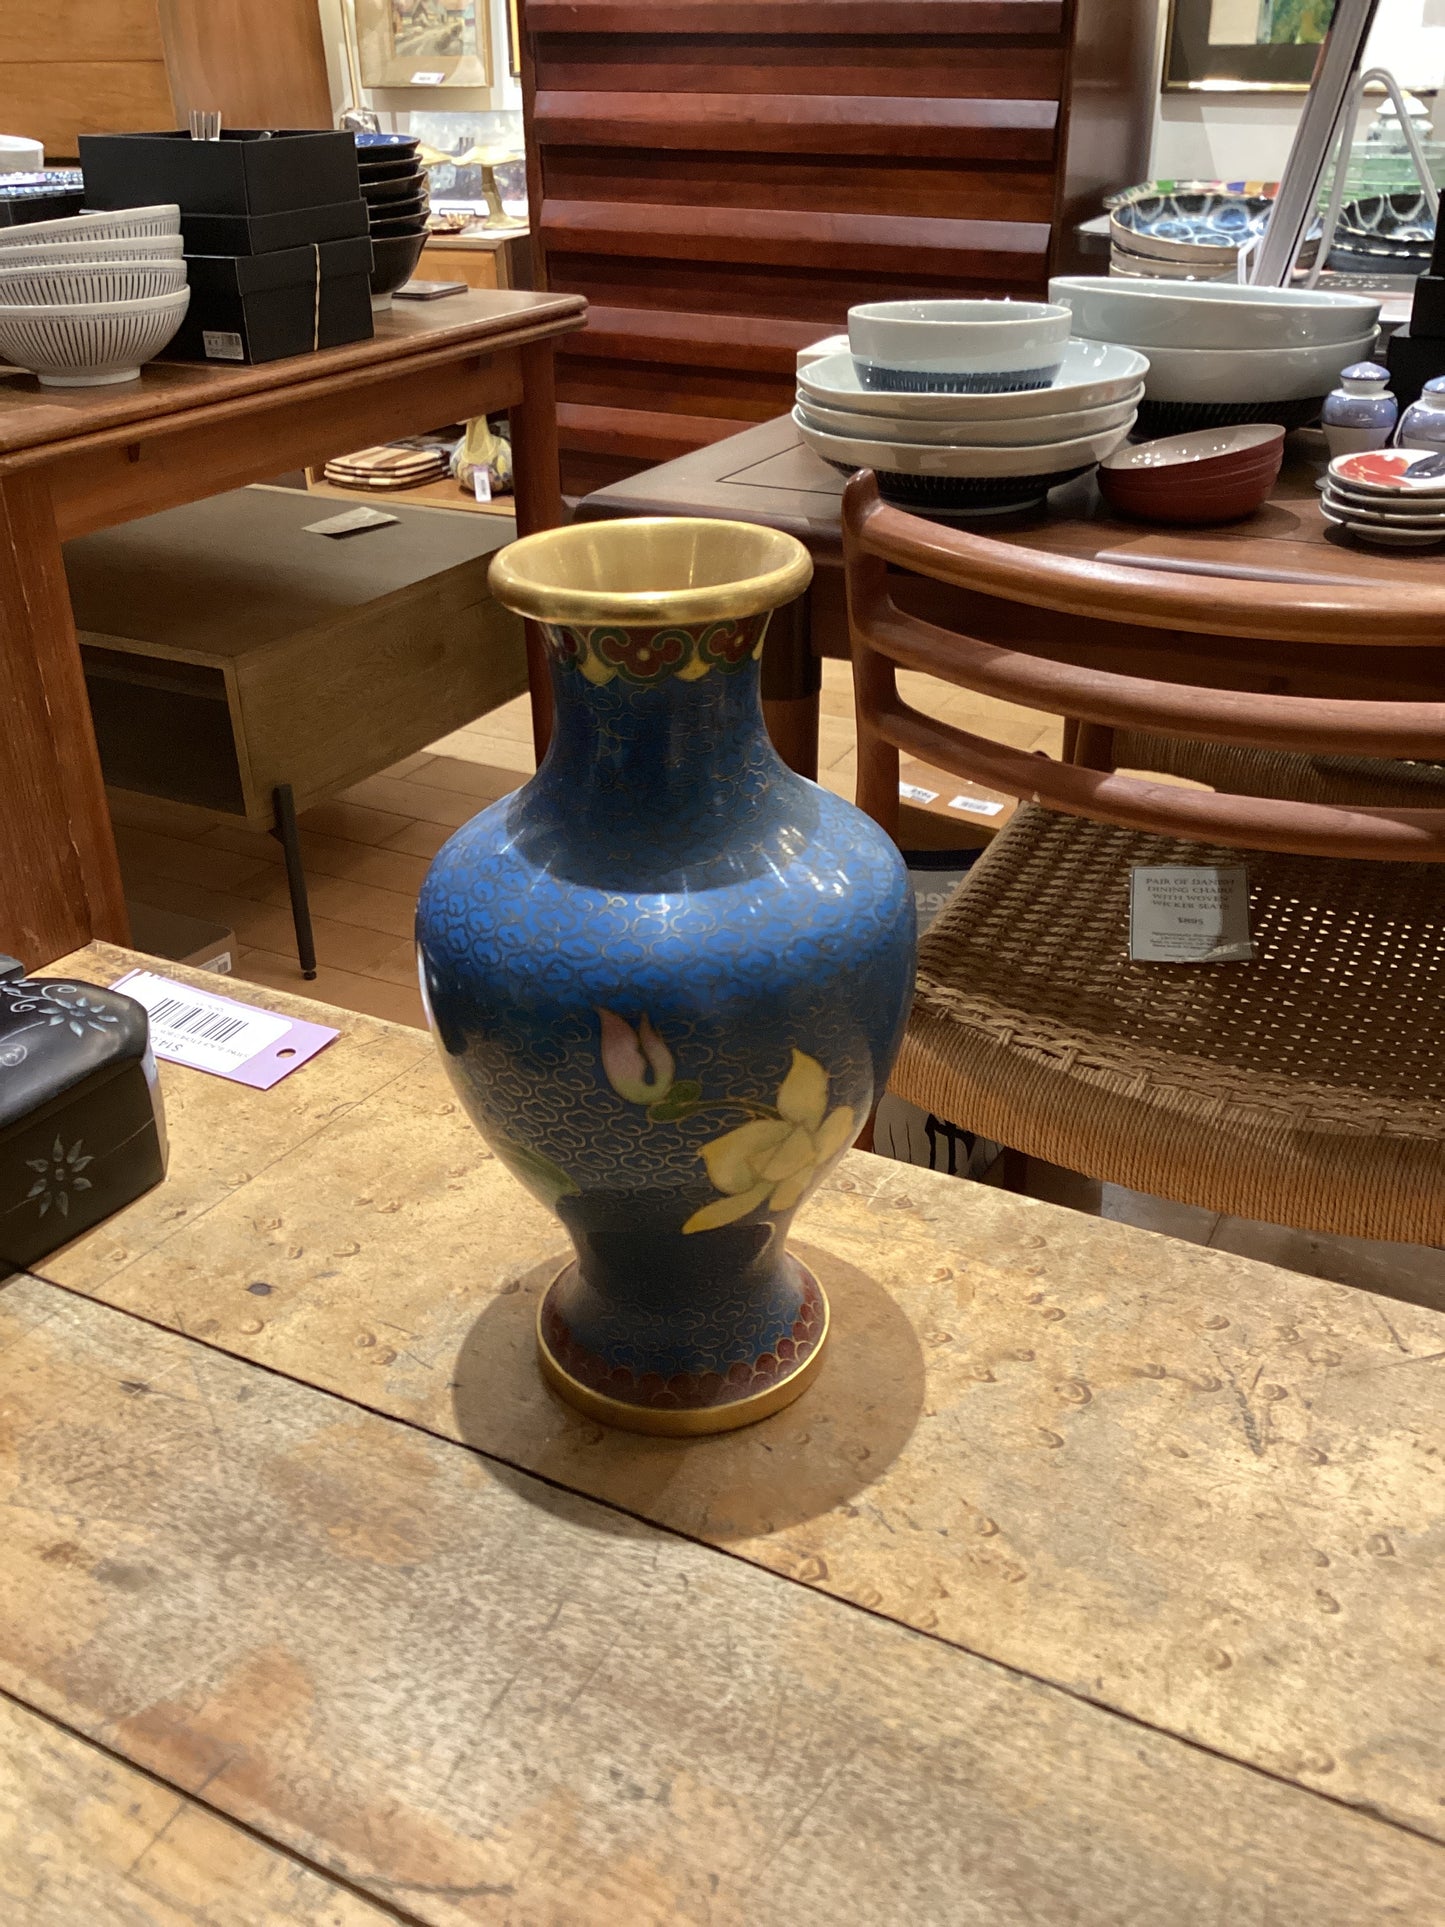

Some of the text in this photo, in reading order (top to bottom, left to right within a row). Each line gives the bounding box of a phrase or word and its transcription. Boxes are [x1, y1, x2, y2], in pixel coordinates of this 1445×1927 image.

[1146, 878, 1171, 886] PAIR
[1174, 878, 1188, 886] OF
[1147, 886, 1189, 894] DINING
[1152, 893, 1229, 902] WITH WOVEN
[1152, 900, 1195, 909] WICKER
